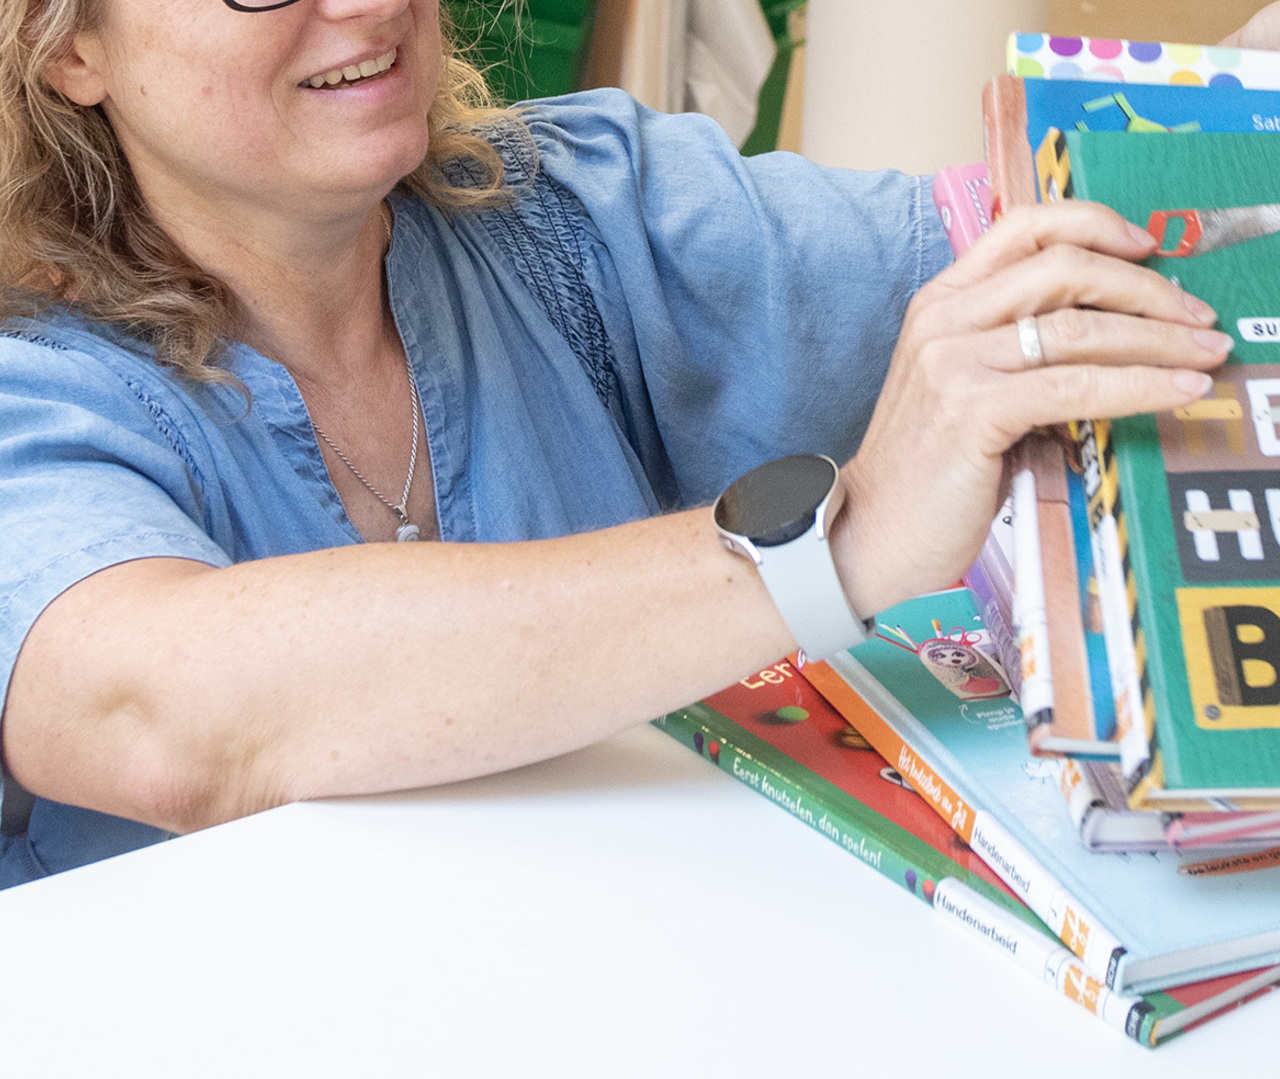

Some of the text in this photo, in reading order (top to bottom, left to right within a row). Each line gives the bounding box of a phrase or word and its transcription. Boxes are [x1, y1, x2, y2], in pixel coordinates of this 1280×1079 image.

[732, 756, 760, 791] Eerst
[818, 812, 839, 841] dan
[841, 832, 882, 869] spelen!
[973, 826, 1031, 894] Handenarbeid
[936, 890, 1018, 955] Handenarbeid
